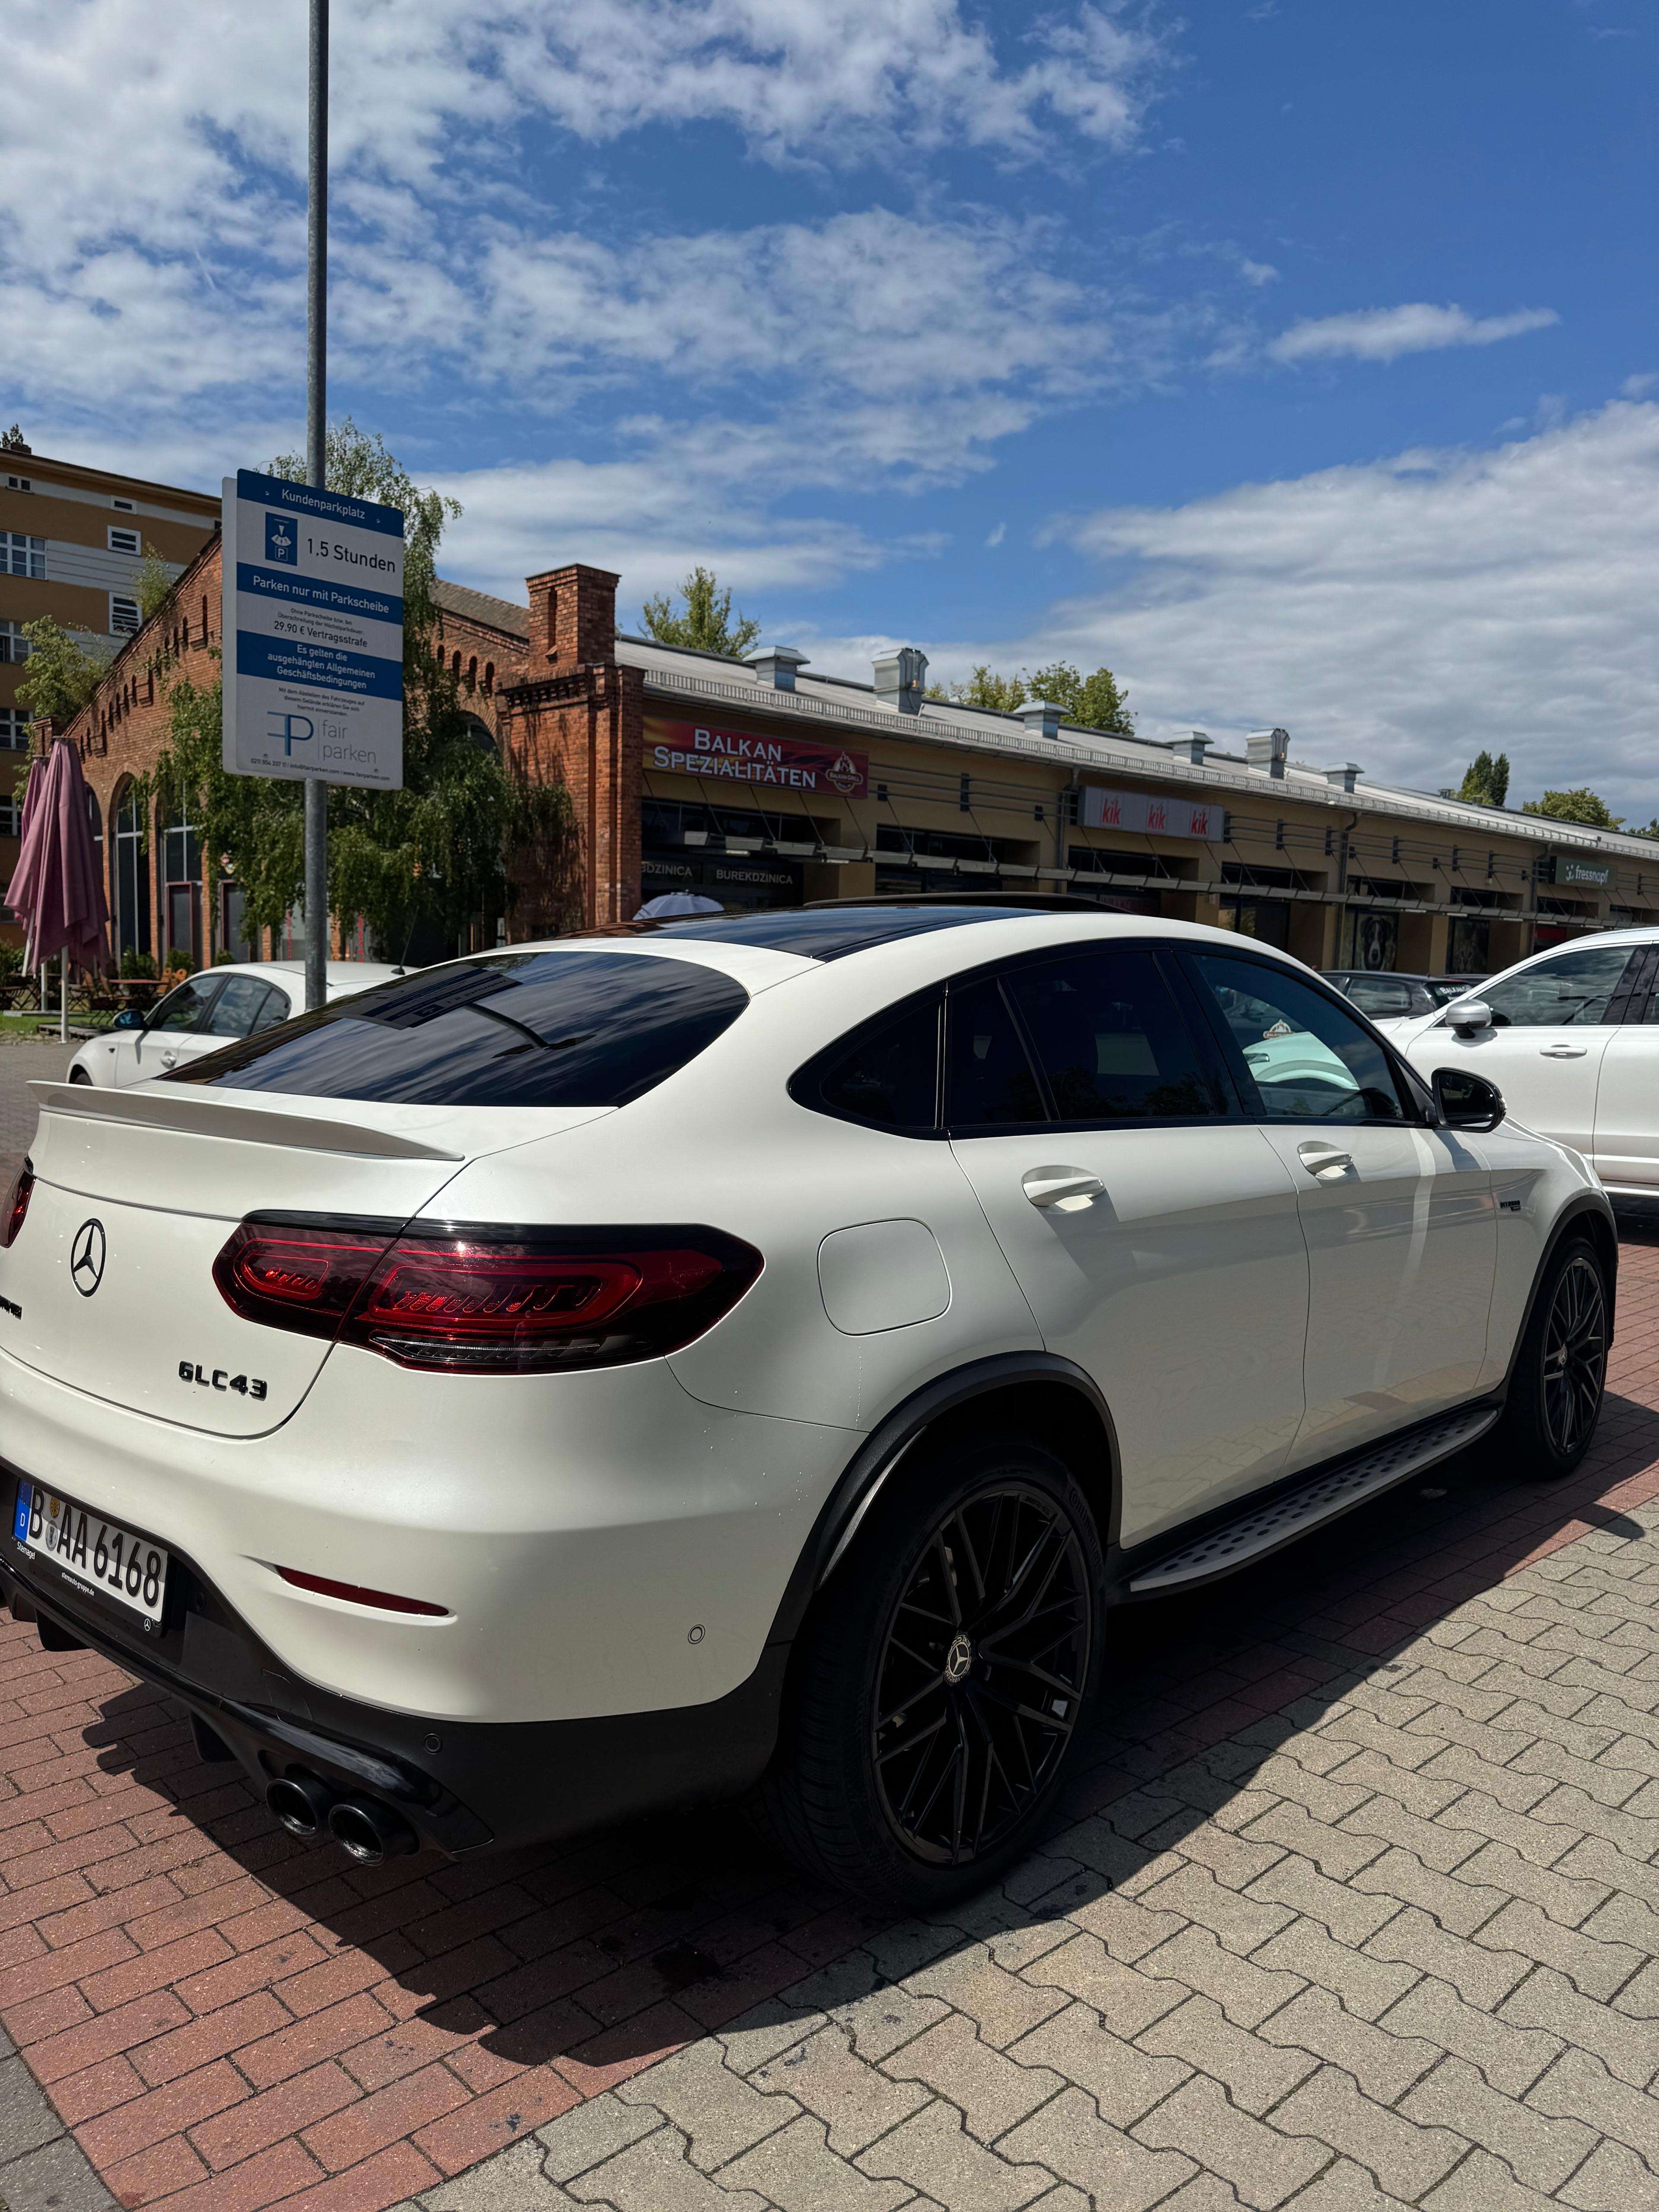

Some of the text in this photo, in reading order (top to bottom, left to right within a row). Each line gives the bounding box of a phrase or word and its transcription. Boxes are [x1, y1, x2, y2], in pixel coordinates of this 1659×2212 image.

[282, 489, 365, 519] Kundenparkplatz
[278, 548, 285, 558] P
[308, 538, 395, 572] 1,5 Stunden
[253, 575, 389, 613] Parken nur mit Parkscheibe
[300, 626, 305, 635] €
[307, 627, 367, 647] Vertragsstrafe
[297, 645, 347, 661] Es gelten die
[267, 653, 375, 679] ausgehängten Allgemeinen
[277, 666, 367, 689] Geschäftsbedingungen
[322, 720, 347, 739] fair
[323, 744, 376, 764] parken
[694, 728, 782, 762] BALKAN
[654, 745, 816, 788] SPEZIALITÄTEN
[1102, 797, 1208, 835] kik kik kik
[716, 869, 793, 884] BUREKDZINICA
[1576, 865, 1609, 885] fressnapf
[178, 1360, 267, 1402] GLC43
[20, 1513, 25, 1527] D
[29, 1487, 161, 1608] B AA 6168
